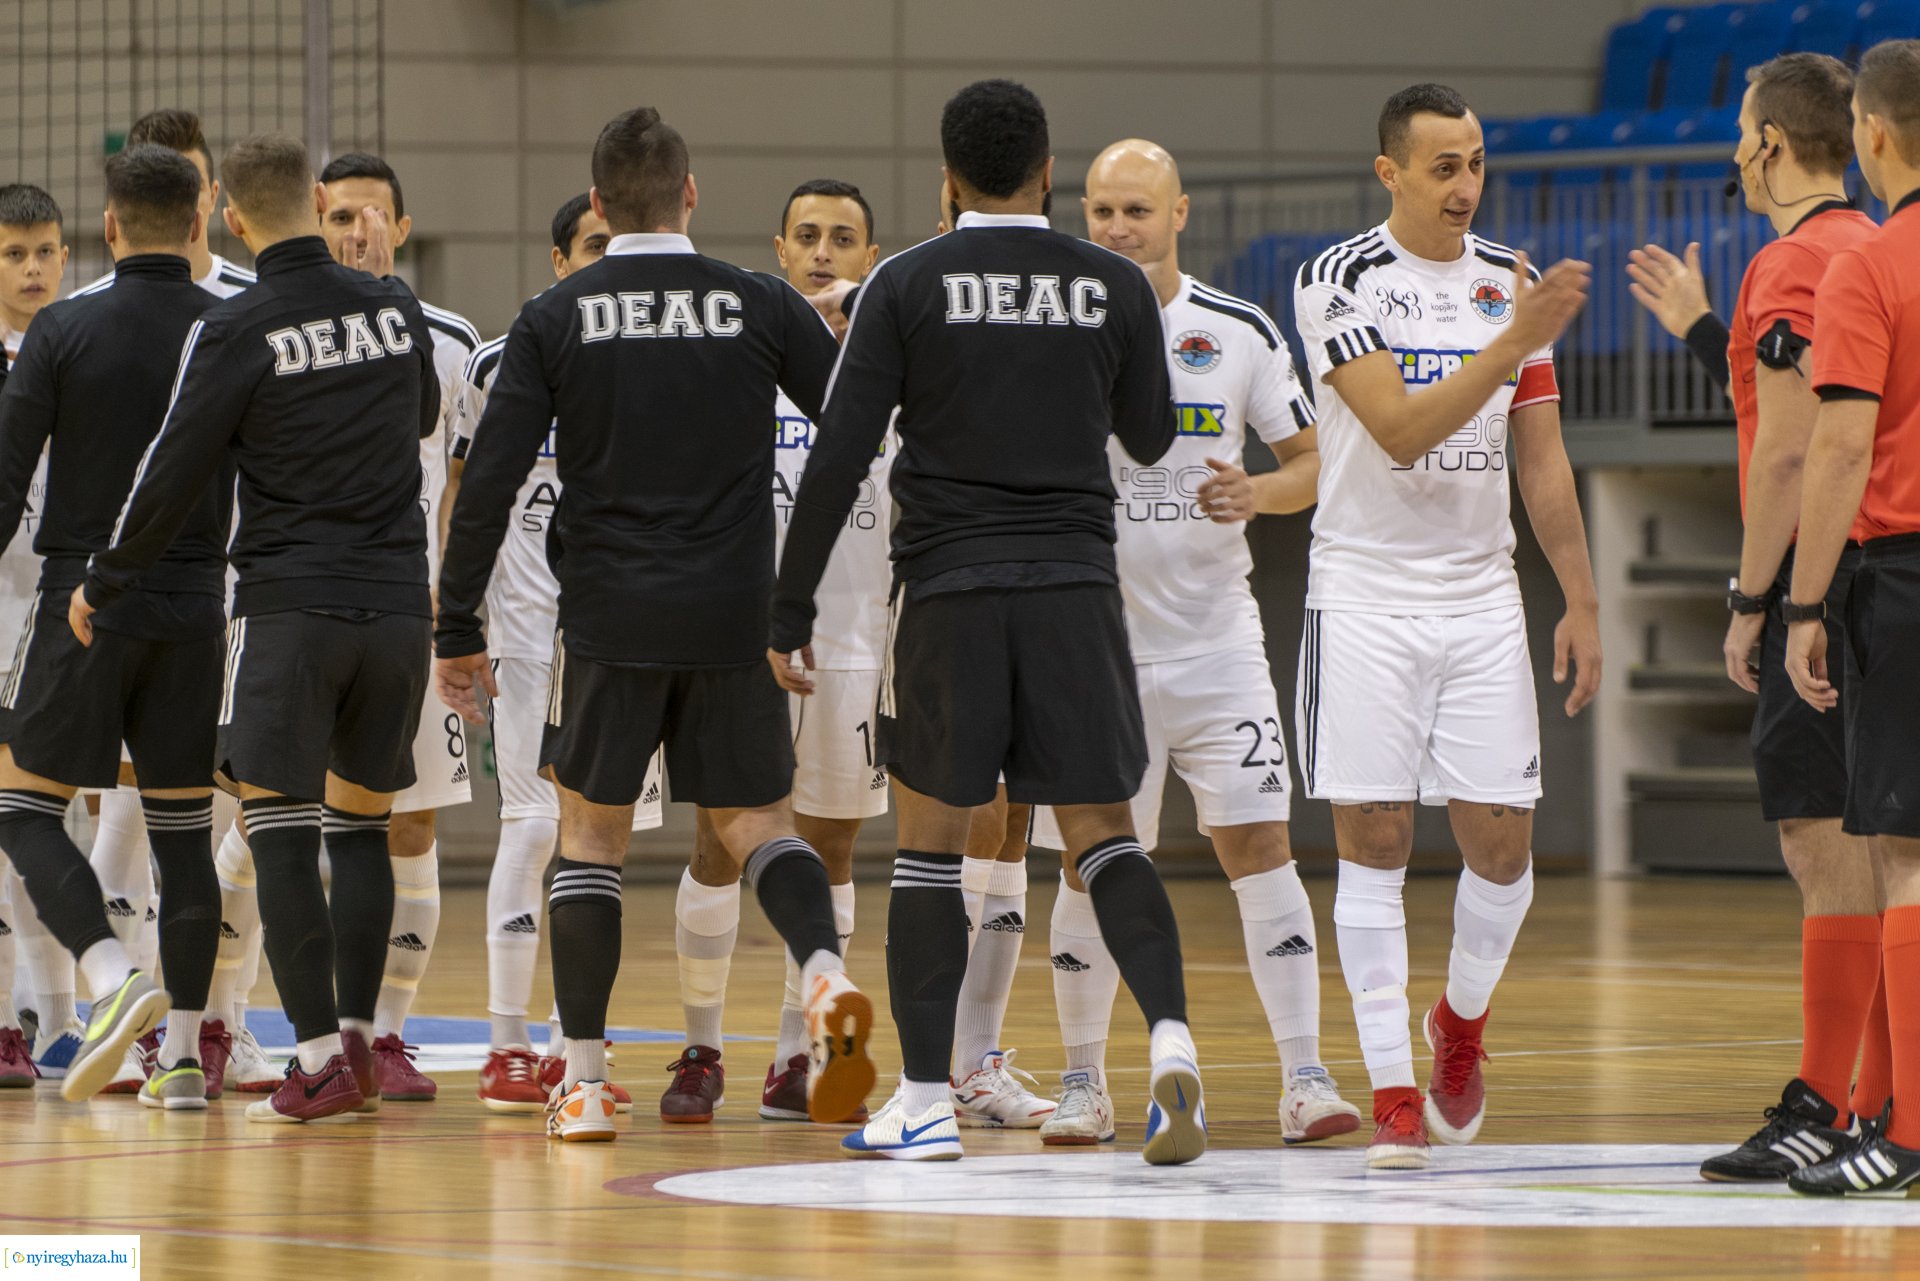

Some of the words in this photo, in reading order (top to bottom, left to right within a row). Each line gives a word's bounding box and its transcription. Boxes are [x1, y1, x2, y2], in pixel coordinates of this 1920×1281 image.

[942, 272, 1108, 328] DEAC
[1324, 306, 1355, 321] adidas
[1375, 286, 1422, 320] 383
[1435, 291, 1449, 300] the
[577, 290, 743, 344] DEAC
[265, 307, 413, 376] DEAC
[1391, 451, 1505, 471] TUDIO
[444, 713, 464, 758] 8
[1235, 716, 1284, 768] 23
[1265, 945, 1313, 956] adidas
